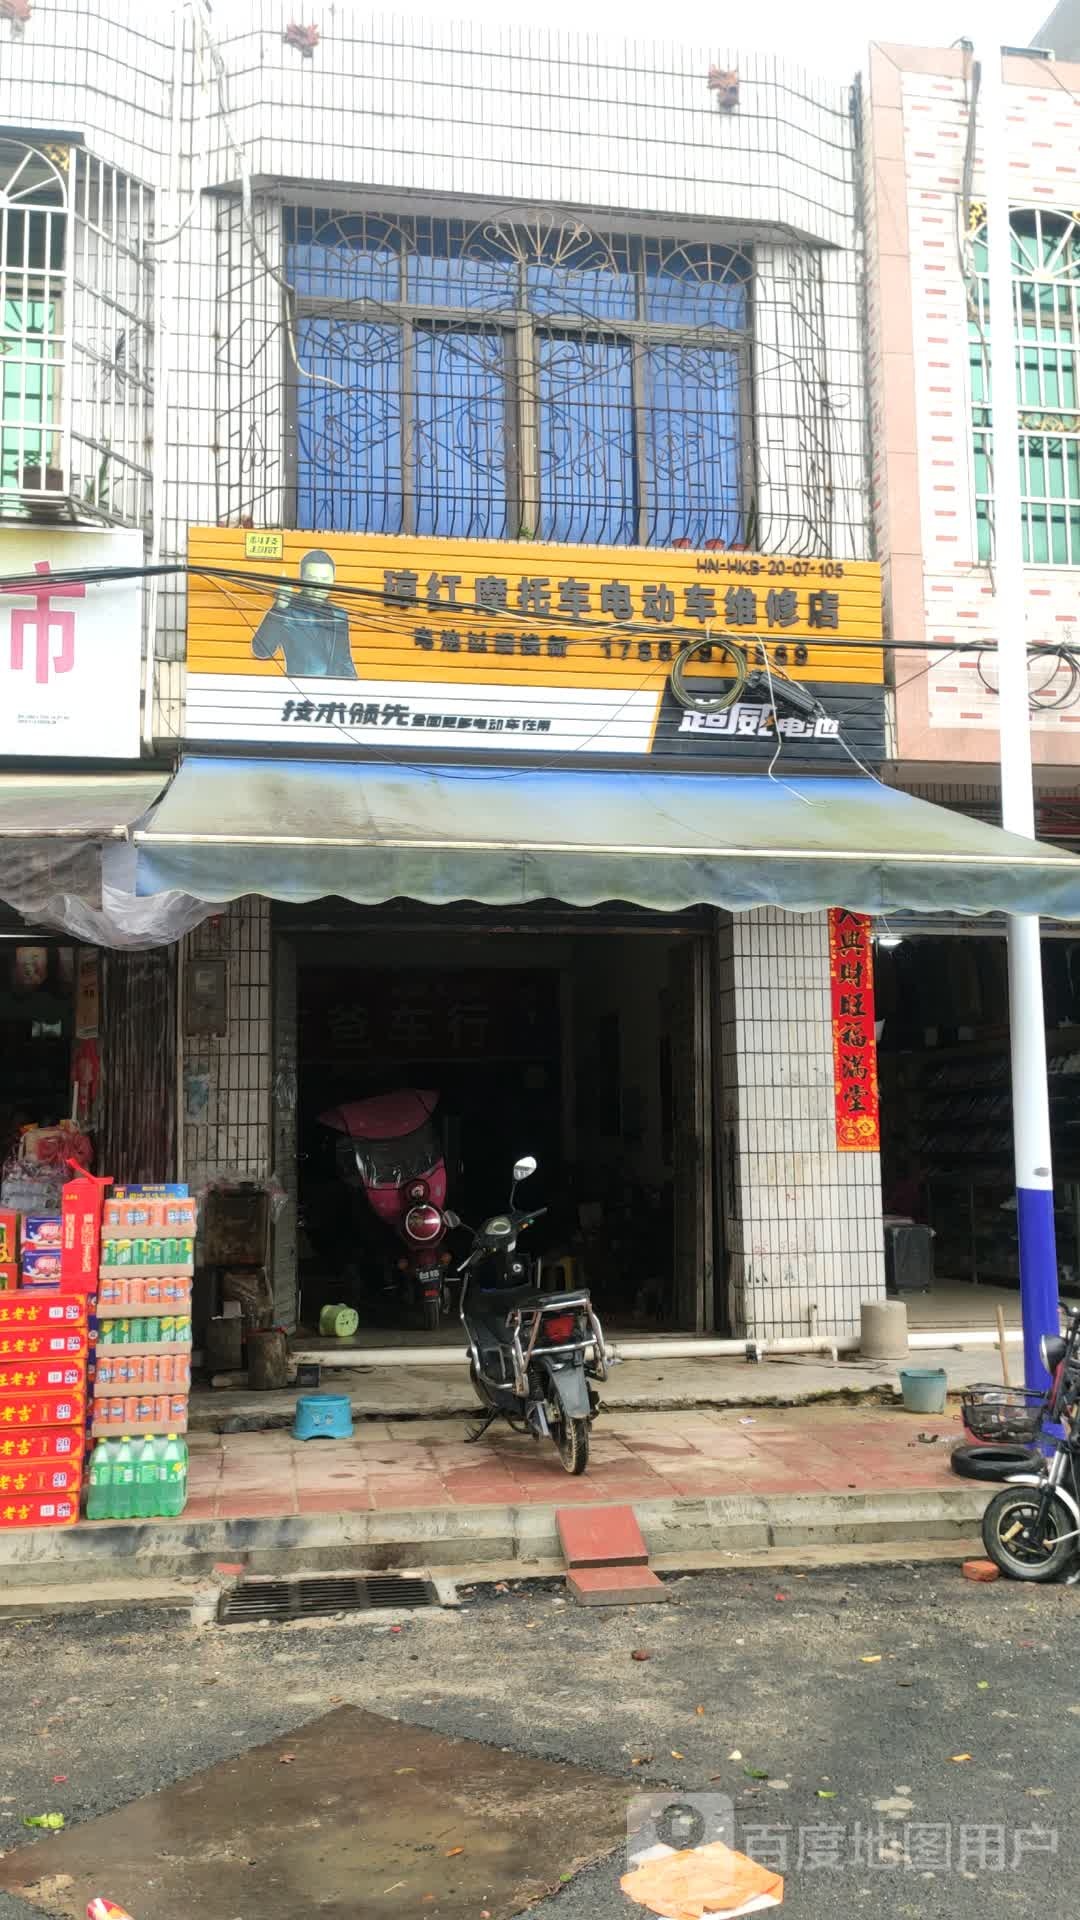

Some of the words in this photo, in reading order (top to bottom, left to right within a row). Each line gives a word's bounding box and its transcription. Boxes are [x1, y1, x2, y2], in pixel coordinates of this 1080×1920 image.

[383, 569, 839, 629] 琼红摩托车电动车维修店
[0, 561, 86, 684] 市
[281, 699, 410, 727] 技术领先
[0, 1306, 40, 1321] 王老吉
[0, 1337, 41, 1353] 王老吉
[0, 1404, 32, 1421] 老吉
[0, 1439, 31, 1456] 老吉
[3, 1505, 30, 1520] 老吉
